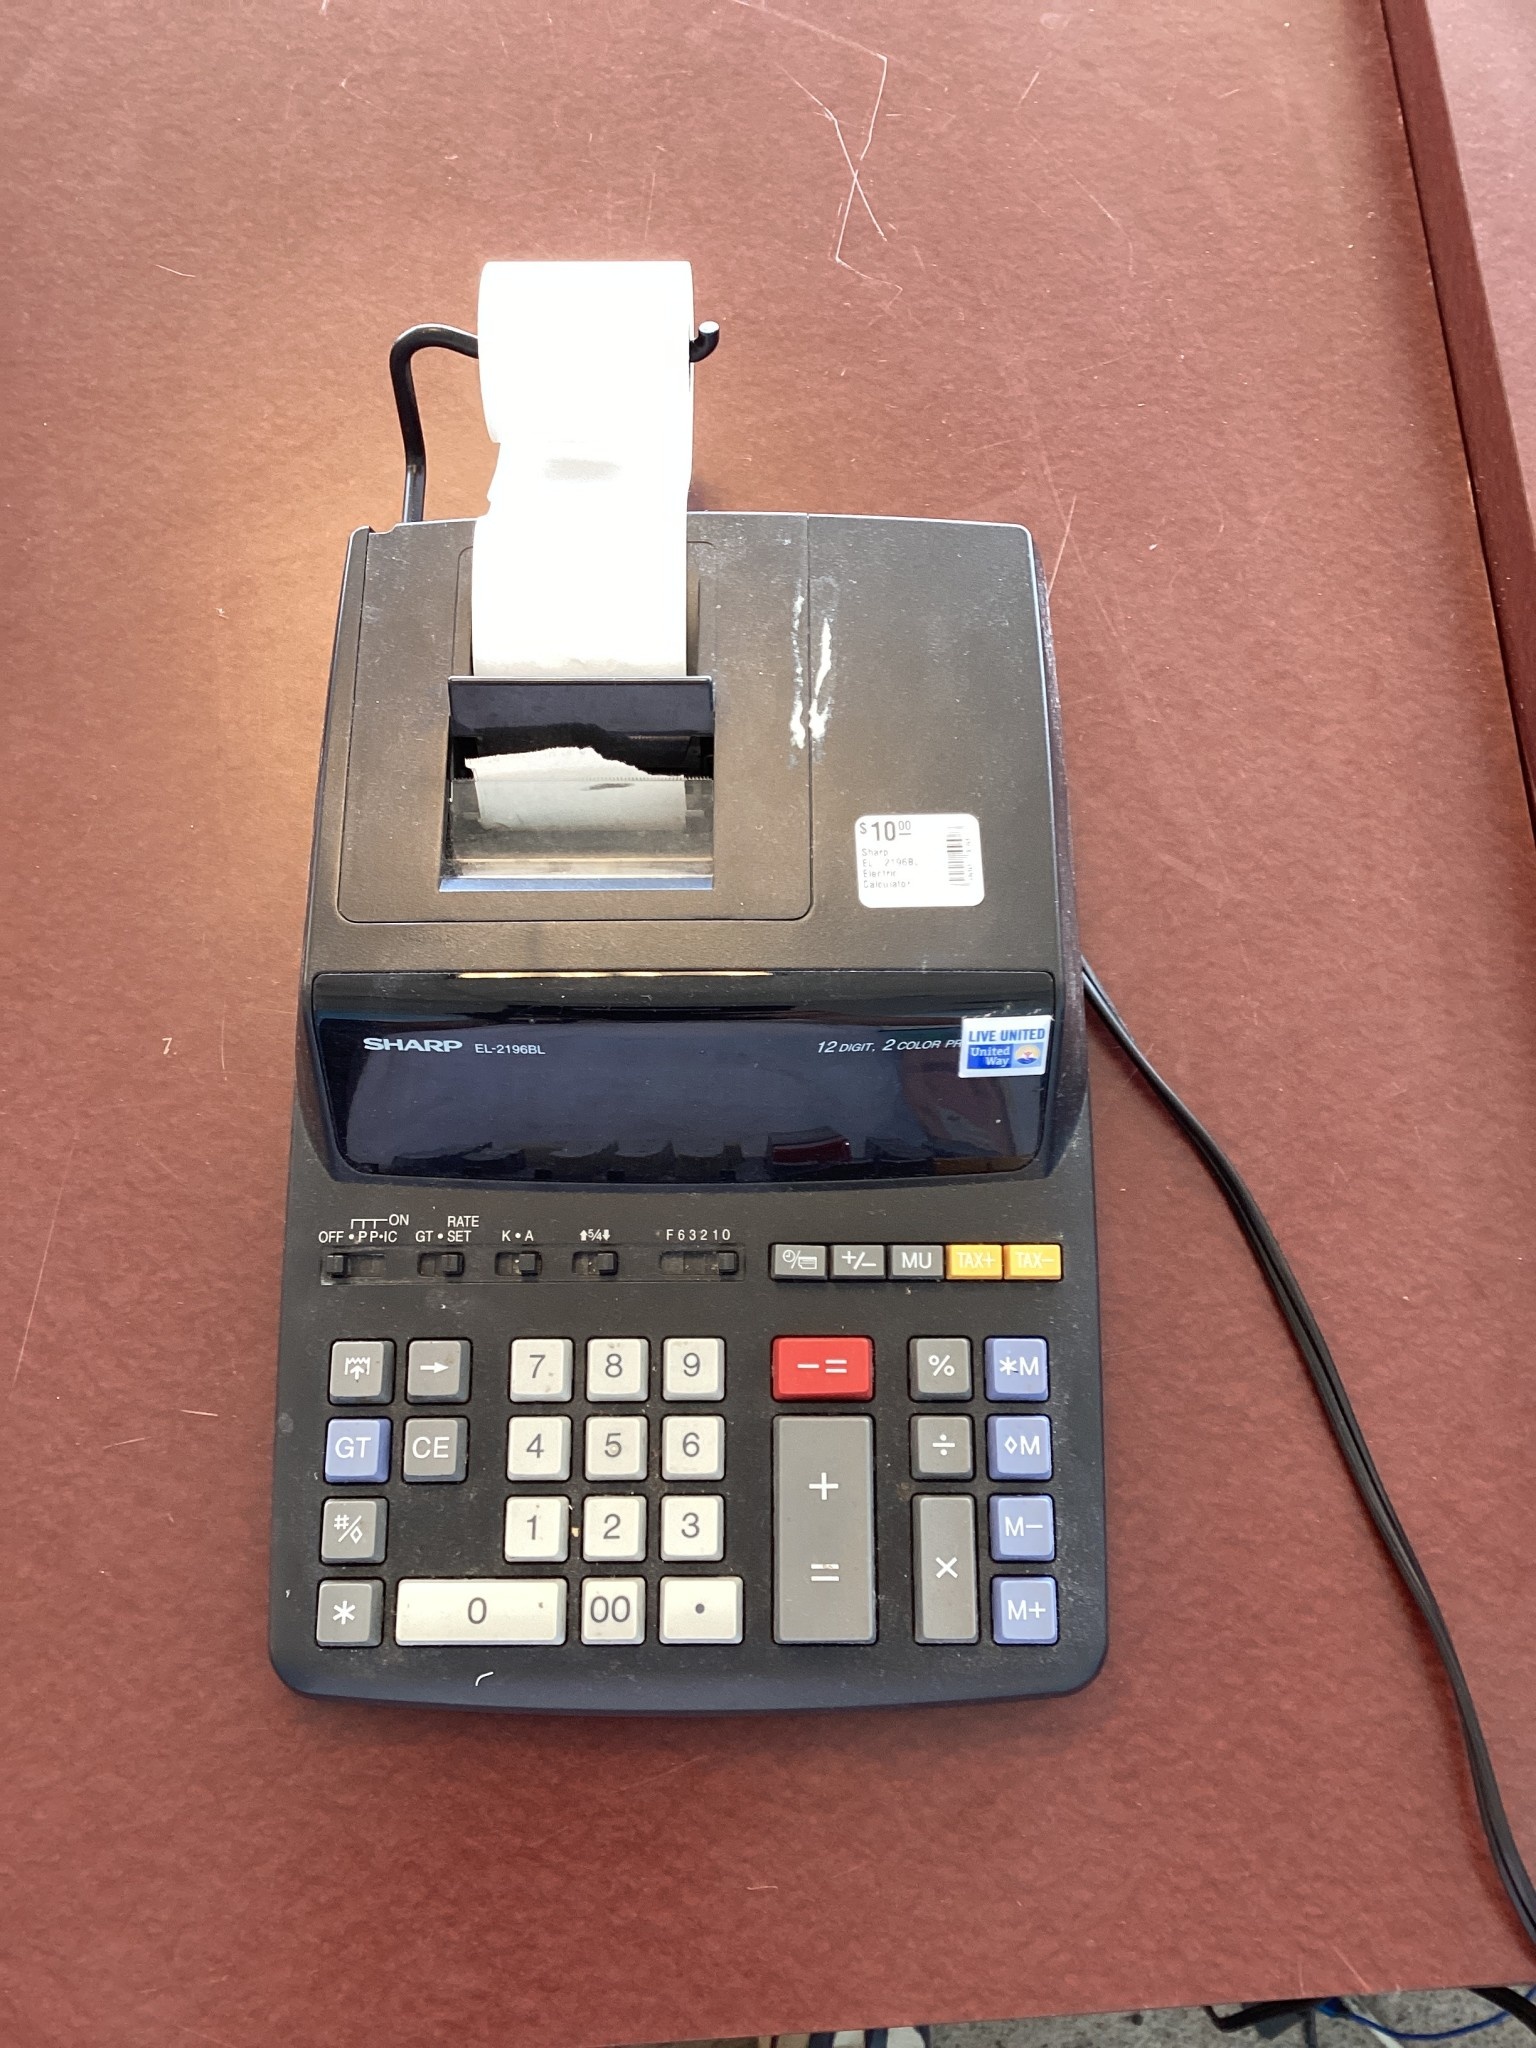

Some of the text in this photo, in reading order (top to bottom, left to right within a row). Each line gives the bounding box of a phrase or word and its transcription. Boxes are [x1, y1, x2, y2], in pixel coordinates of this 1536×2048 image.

[363, 1037, 546, 1055] SHARP EL-2196BL
[816, 1041, 836, 1053] 12
[838, 1042, 875, 1053] DIGIT,
[882, 1039, 894, 1051] 2
[897, 1040, 941, 1051] COLOR
[969, 1028, 1045, 1042] LIVE UNITED
[970, 1046, 1010, 1057] United
[985, 1056, 1009, 1067] Way
[388, 1214, 409, 1226] ON
[447, 1215, 479, 1228] RATE
[318, 1230, 344, 1243] OFF
[415, 1230, 472, 1242] GT SET
[901, 1252, 932, 1269] MU
[956, 1251, 996, 1269] TAX+
[529, 1354, 546, 1379] 7
[605, 1353, 623, 1378] 8
[683, 1352, 701, 1377] 9
[334, 1436, 372, 1459] GT
[411, 1436, 450, 1459] CE
[526, 1433, 545, 1459] 4
[604, 1432, 622, 1458] 5
[682, 1432, 700, 1457] 6
[526, 1514, 538, 1541] 1
[602, 1513, 622, 1540] 2
[681, 1512, 701, 1539] 3
[467, 1597, 487, 1625] 0
[590, 1595, 632, 1623] 00
[1007, 1599, 1046, 1620] M+
